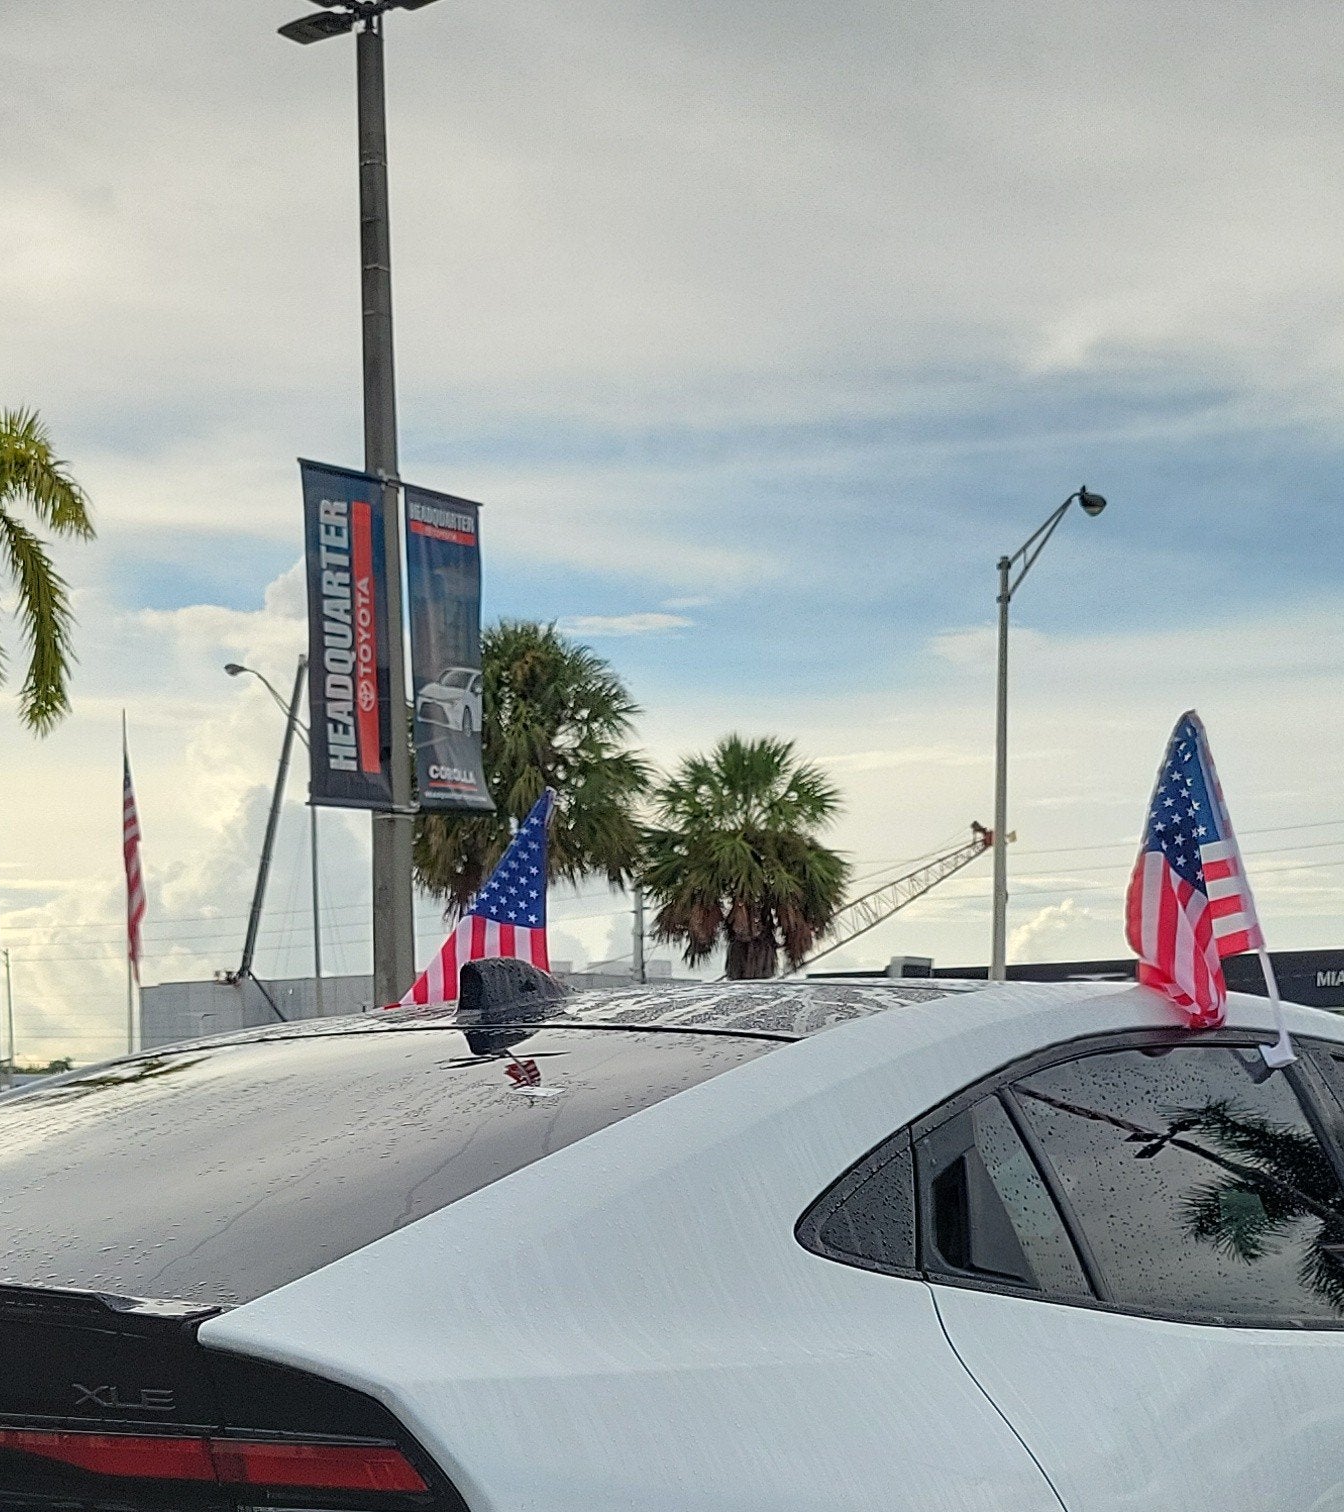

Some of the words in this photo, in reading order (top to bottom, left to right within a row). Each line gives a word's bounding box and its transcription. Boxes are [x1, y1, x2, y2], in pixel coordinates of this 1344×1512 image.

[319, 498, 358, 772] HEADQUARTER
[358, 576, 374, 677] TOYOTA
[72, 1383, 176, 1411] XLE
